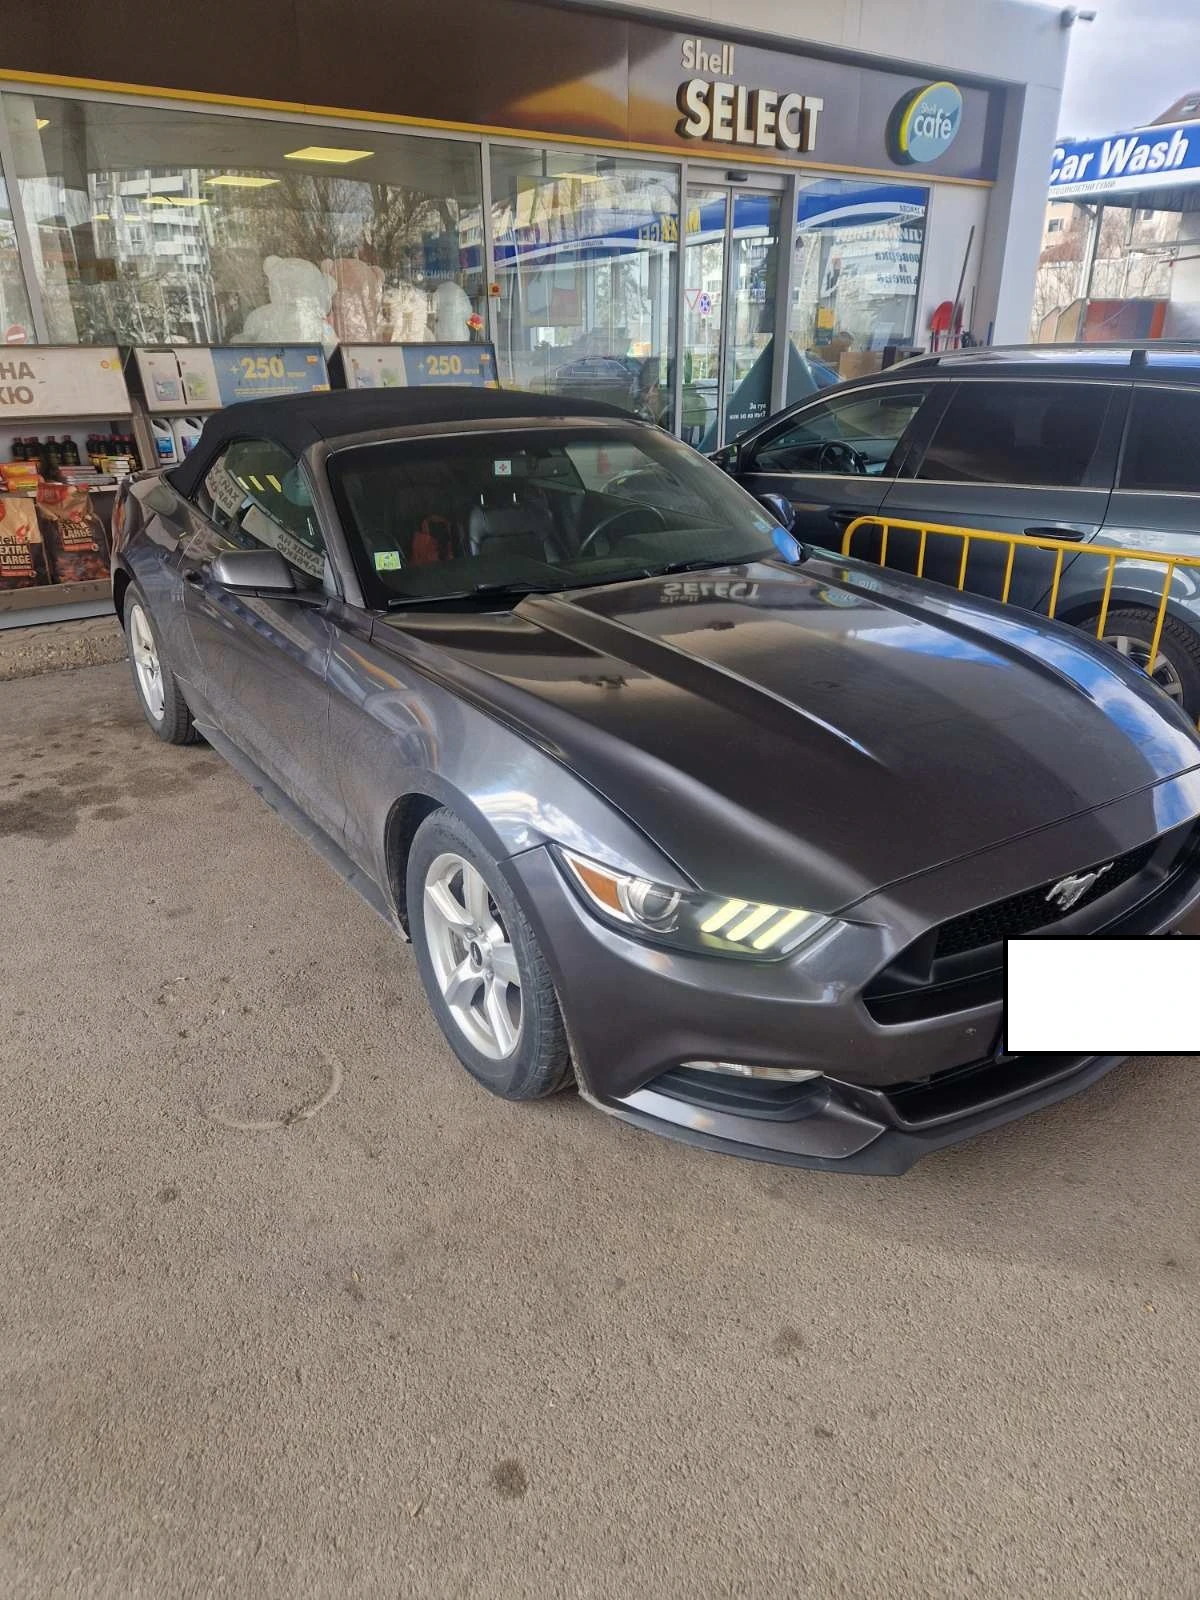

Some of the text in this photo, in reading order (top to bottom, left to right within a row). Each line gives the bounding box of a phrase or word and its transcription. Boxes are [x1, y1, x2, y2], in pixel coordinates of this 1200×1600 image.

[682, 39, 734, 75] Shell
[684, 78, 824, 151] SELECT
[914, 108, 952, 140] café
[1050, 128, 1189, 184] Car Wash
[0, 545, 30, 555] EXTRA
[63, 529, 93, 539] LARGE
[1, 555, 32, 565] LARGE
